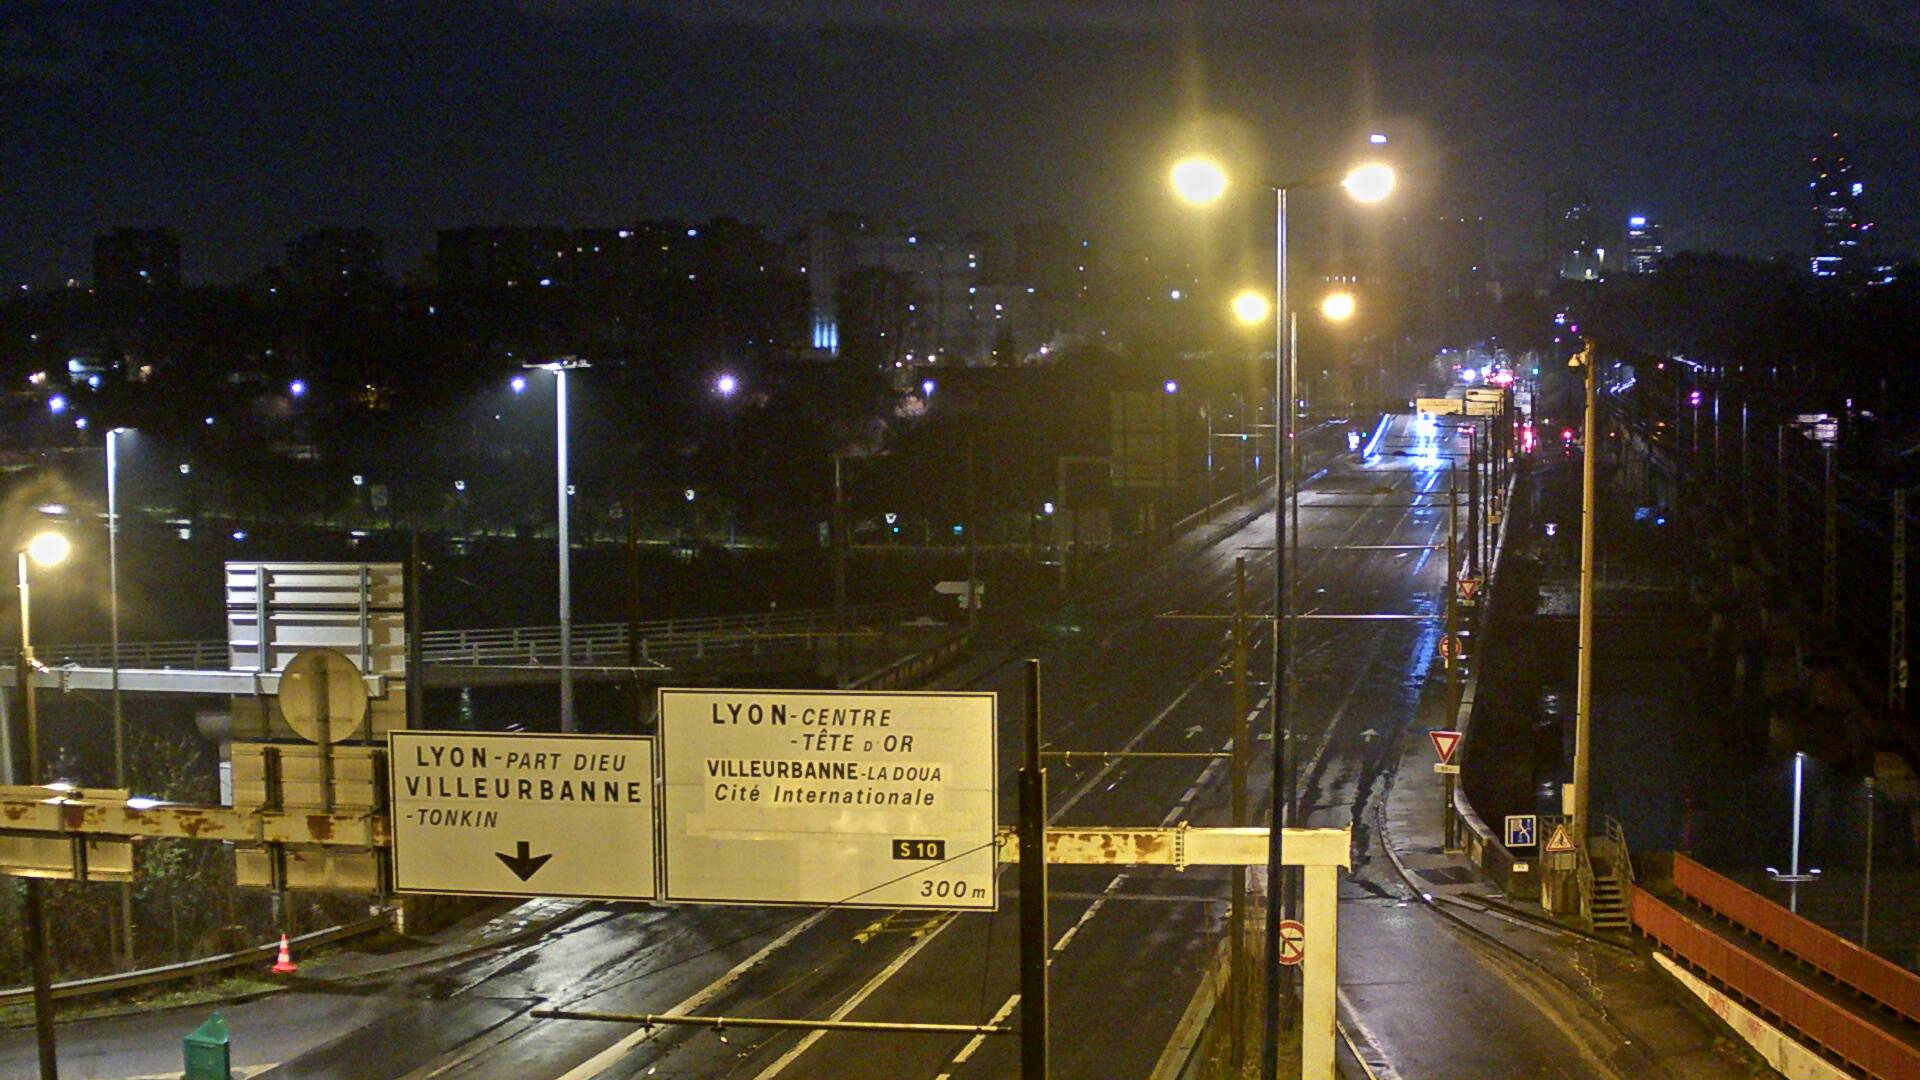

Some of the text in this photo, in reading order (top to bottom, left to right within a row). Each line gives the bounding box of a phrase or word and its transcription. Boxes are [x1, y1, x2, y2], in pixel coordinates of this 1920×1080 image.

[574, 754, 626, 772] DIEU
[893, 767, 941, 782] DOUA
[406, 776, 641, 803] VILLEURBANNE
[714, 784, 935, 806] Cité Internationale
[406, 809, 497, 828] -TONKIN
